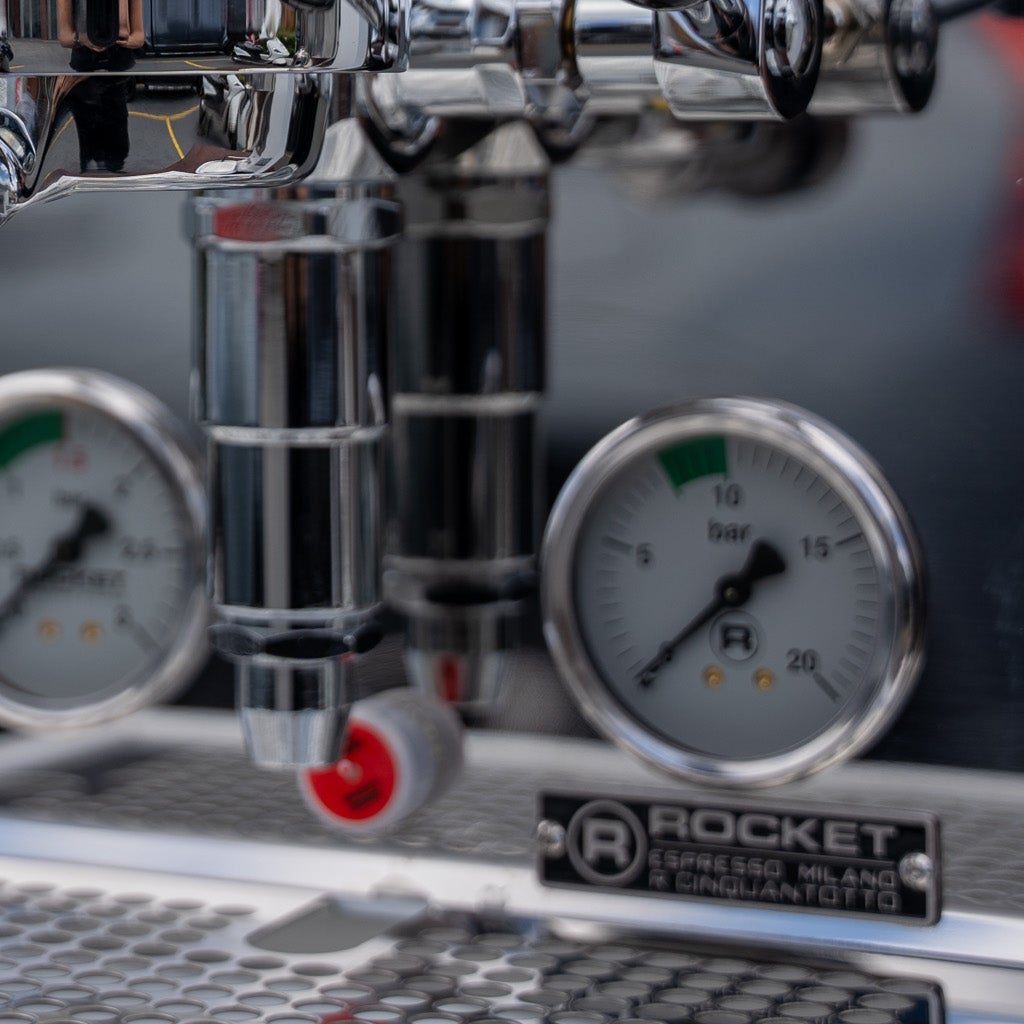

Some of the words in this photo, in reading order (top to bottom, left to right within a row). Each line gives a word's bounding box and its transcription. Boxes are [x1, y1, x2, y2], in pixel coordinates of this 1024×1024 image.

[714, 483, 743, 508] 10
[707, 517, 751, 542] bar
[635, 542, 653, 565] 5
[800, 535, 830, 560] 15
[721, 624, 753, 652] R
[786, 648, 816, 673] 20
[582, 818, 632, 868] R
[648, 804, 898, 857] ROCKET
[648, 848, 784, 877] ESPRESSO
[797, 863, 897, 888] MILANO
